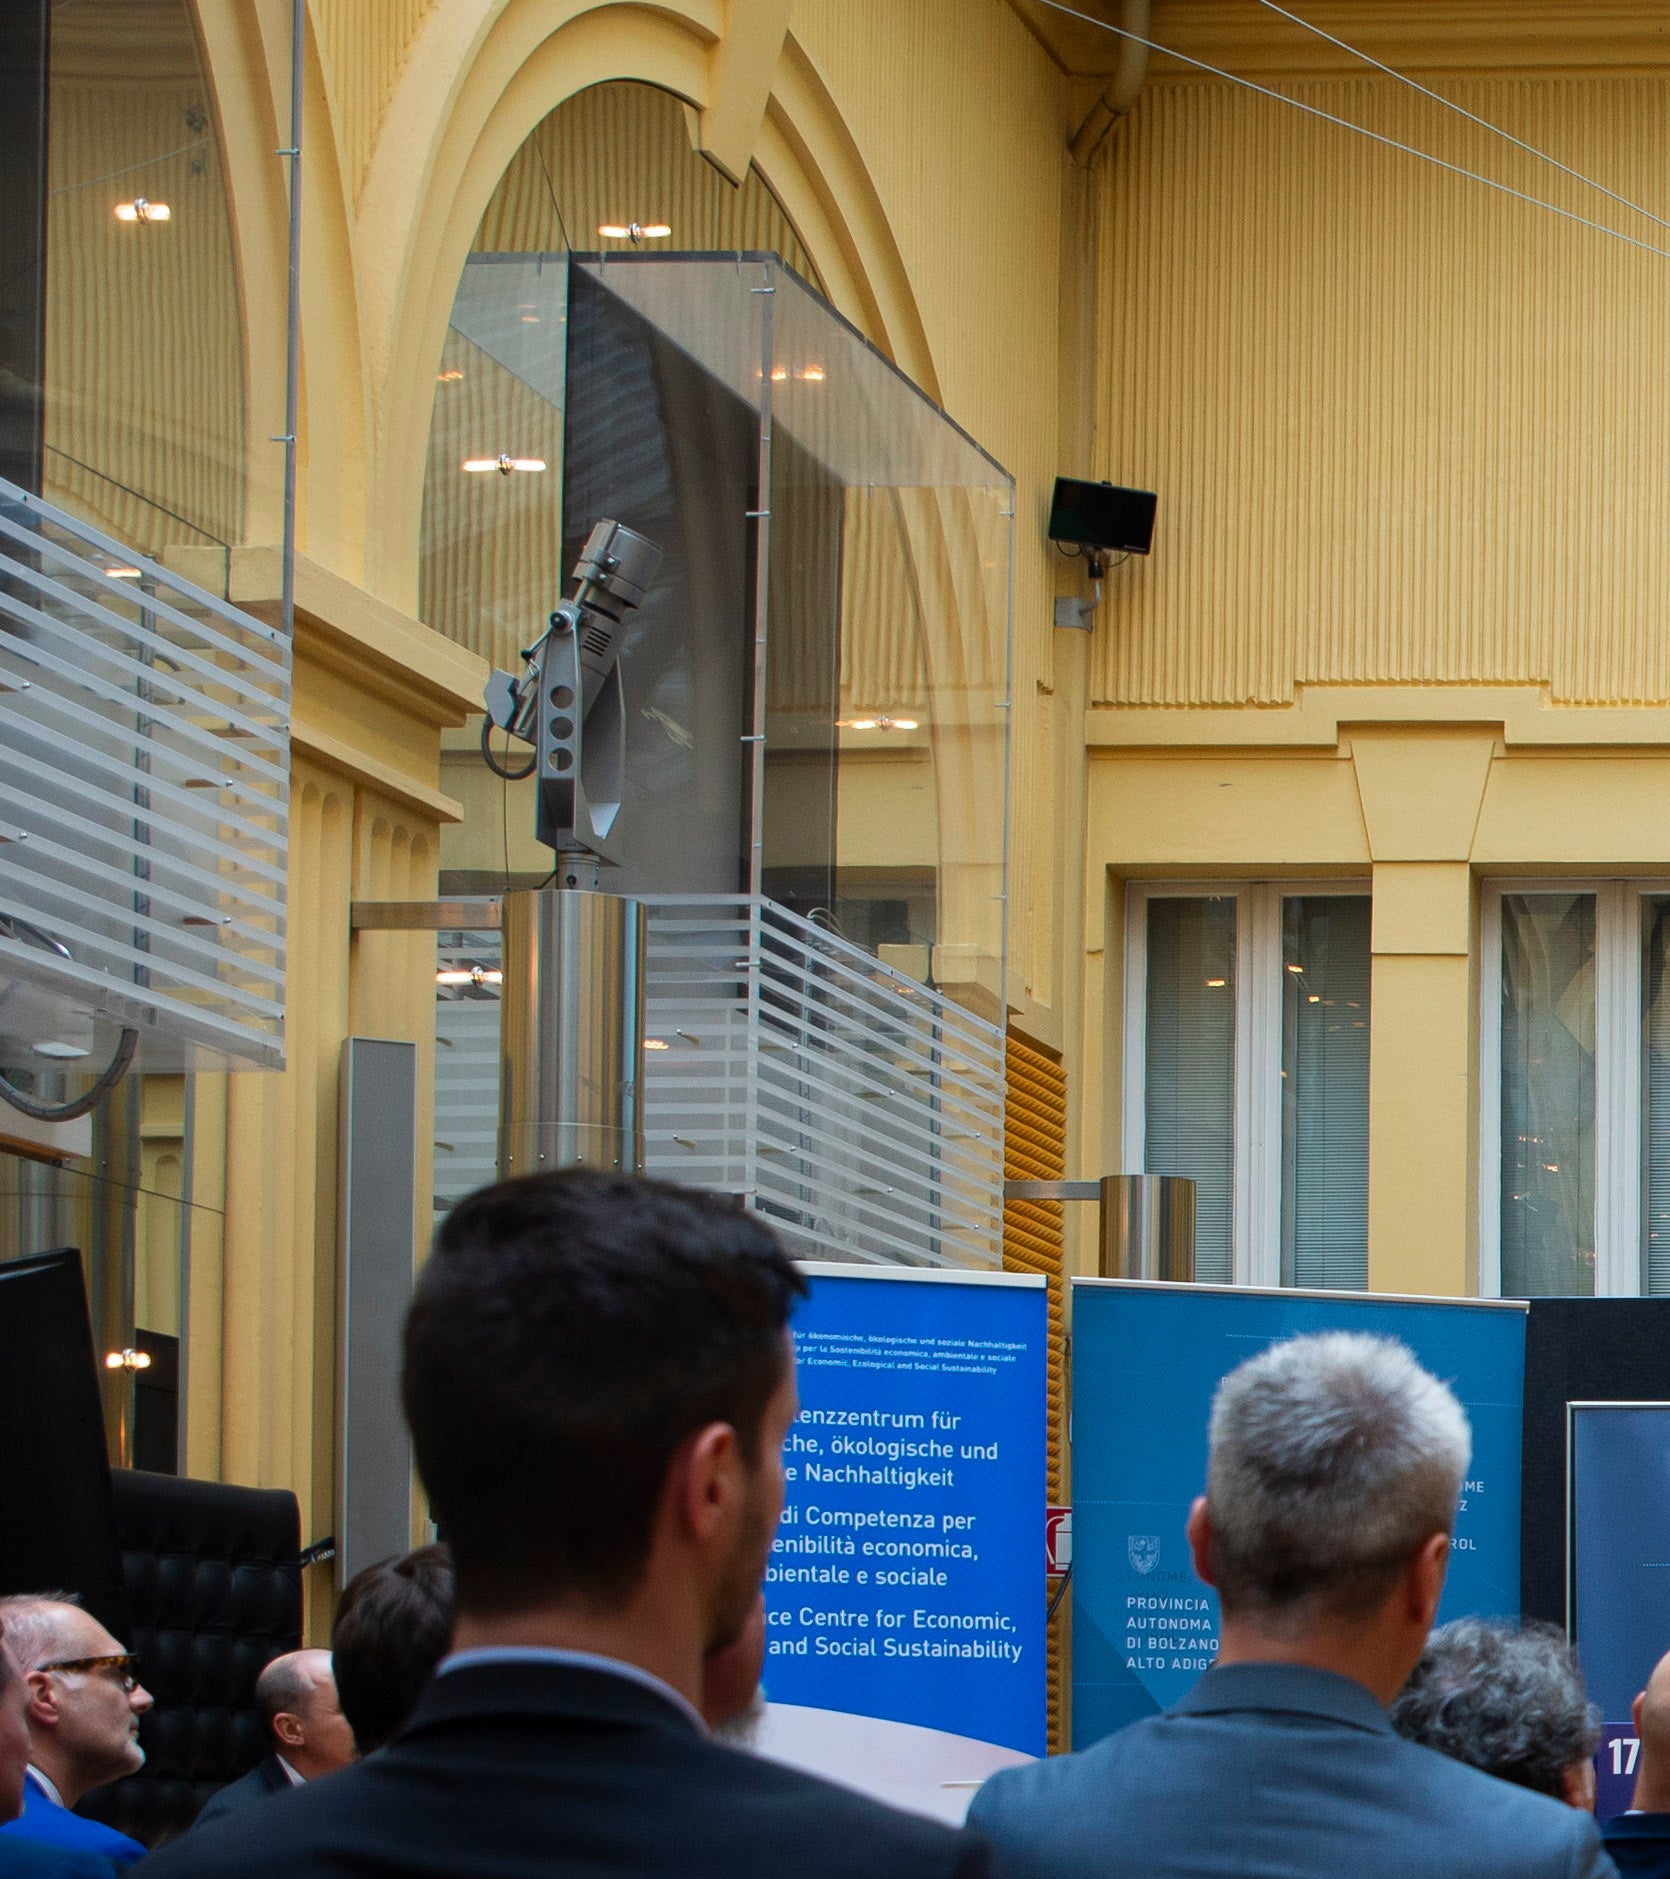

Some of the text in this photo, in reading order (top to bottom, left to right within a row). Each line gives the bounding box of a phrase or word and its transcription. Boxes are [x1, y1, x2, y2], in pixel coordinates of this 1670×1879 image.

[937, 1339, 966, 1347] soziale
[968, 1340, 1027, 1351] Nachhaltigkeit
[852, 1359, 895, 1370] Ecological
[897, 1361, 912, 1369] and
[914, 1362, 939, 1371] Social
[942, 1363, 997, 1375] Sustainability
[932, 1411, 961, 1429] für
[832, 1436, 953, 1461] ökologische
[961, 1442, 997, 1459] und
[806, 1463, 953, 1490] Nachhaltigkeit
[780, 1506, 976, 1533] di Competenza per
[772, 1535, 977, 1561] enibilità economica,
[766, 1564, 947, 1585] bientale e sociale
[1128, 1597, 1209, 1610] PROVINCIA
[800, 1607, 868, 1627] Centre
[876, 1610, 906, 1627] for
[914, 1610, 1016, 1632] Economic,
[1127, 1617, 1211, 1630] AUTONOMA
[769, 1637, 1022, 1663] and Social Sustainability
[1127, 1637, 1218, 1650] DI BOLZANO
[1127, 1657, 1215, 1670] ALTO ADIG
[1609, 1739, 1641, 1774] 17
